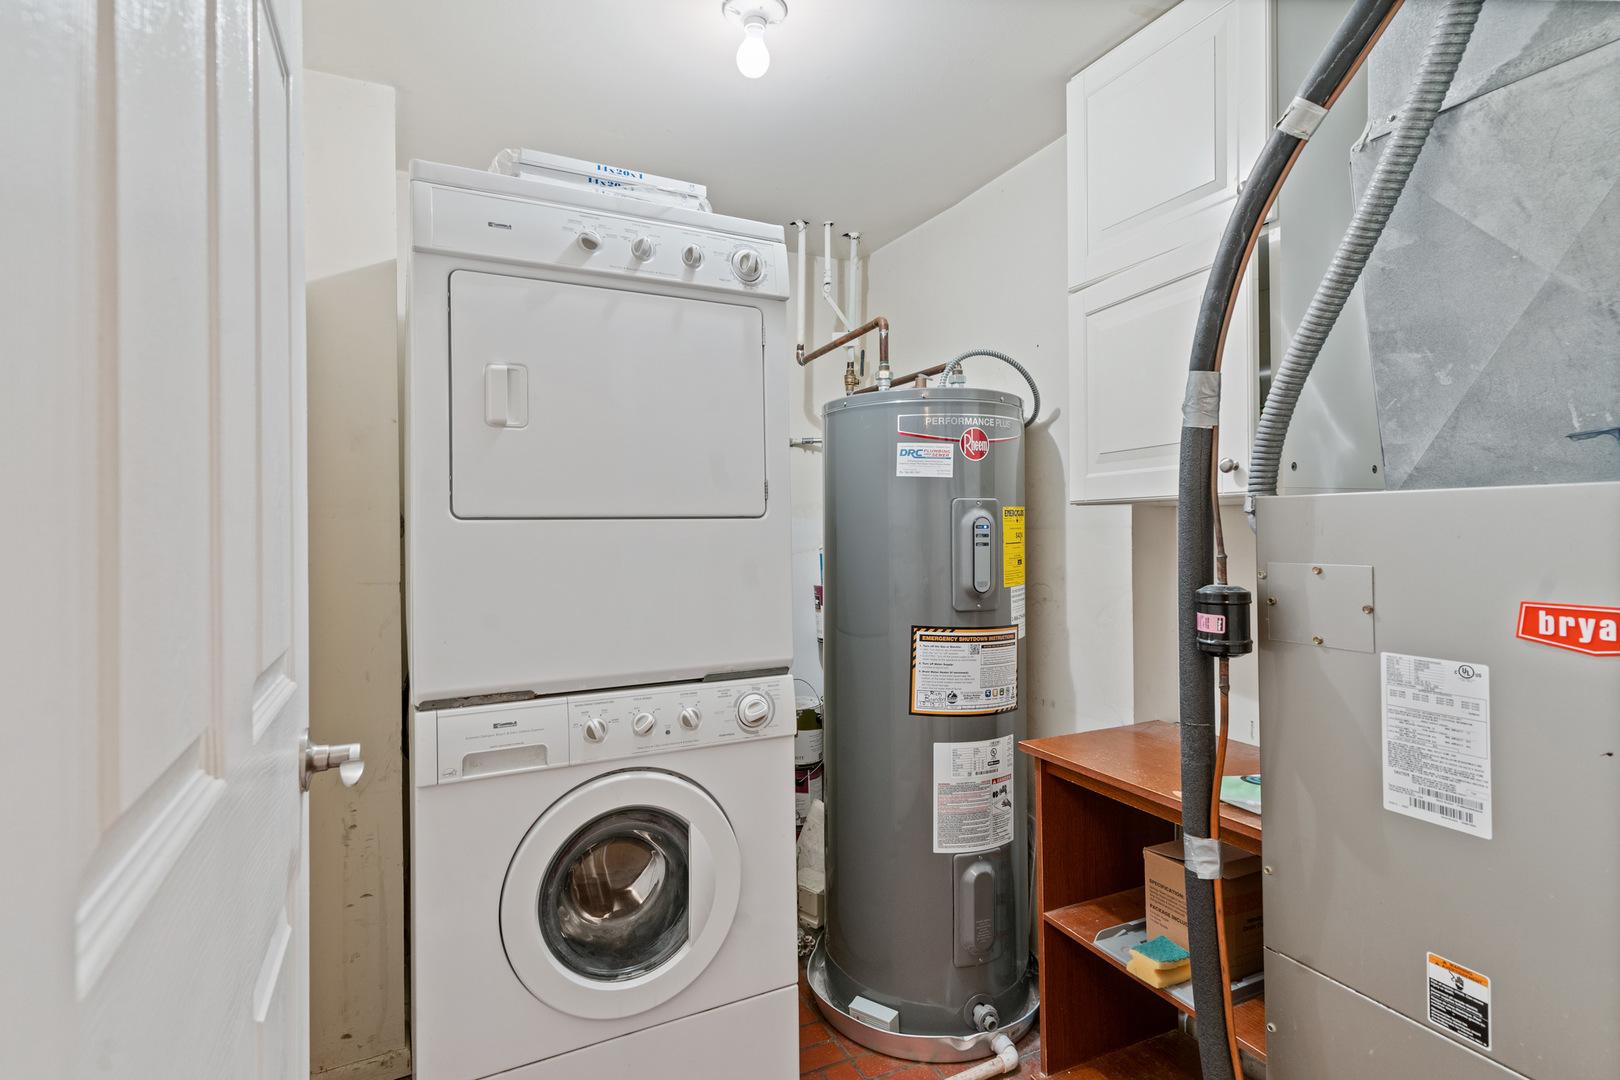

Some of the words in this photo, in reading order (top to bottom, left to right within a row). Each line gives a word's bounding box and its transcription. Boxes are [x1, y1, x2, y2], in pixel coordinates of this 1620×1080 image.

[925, 417, 994, 427] PERFORMANCE
[995, 418, 1011, 429] PLUS
[963, 428, 988, 456] Rheem
[899, 449, 923, 457] DRC
[1538, 610, 1617, 644] brya
[988, 633, 1015, 641] INSTRUCTIONS
[1149, 878, 1185, 899] SPECIFICATION:
[1149, 903, 1171, 918] PACKAGE
